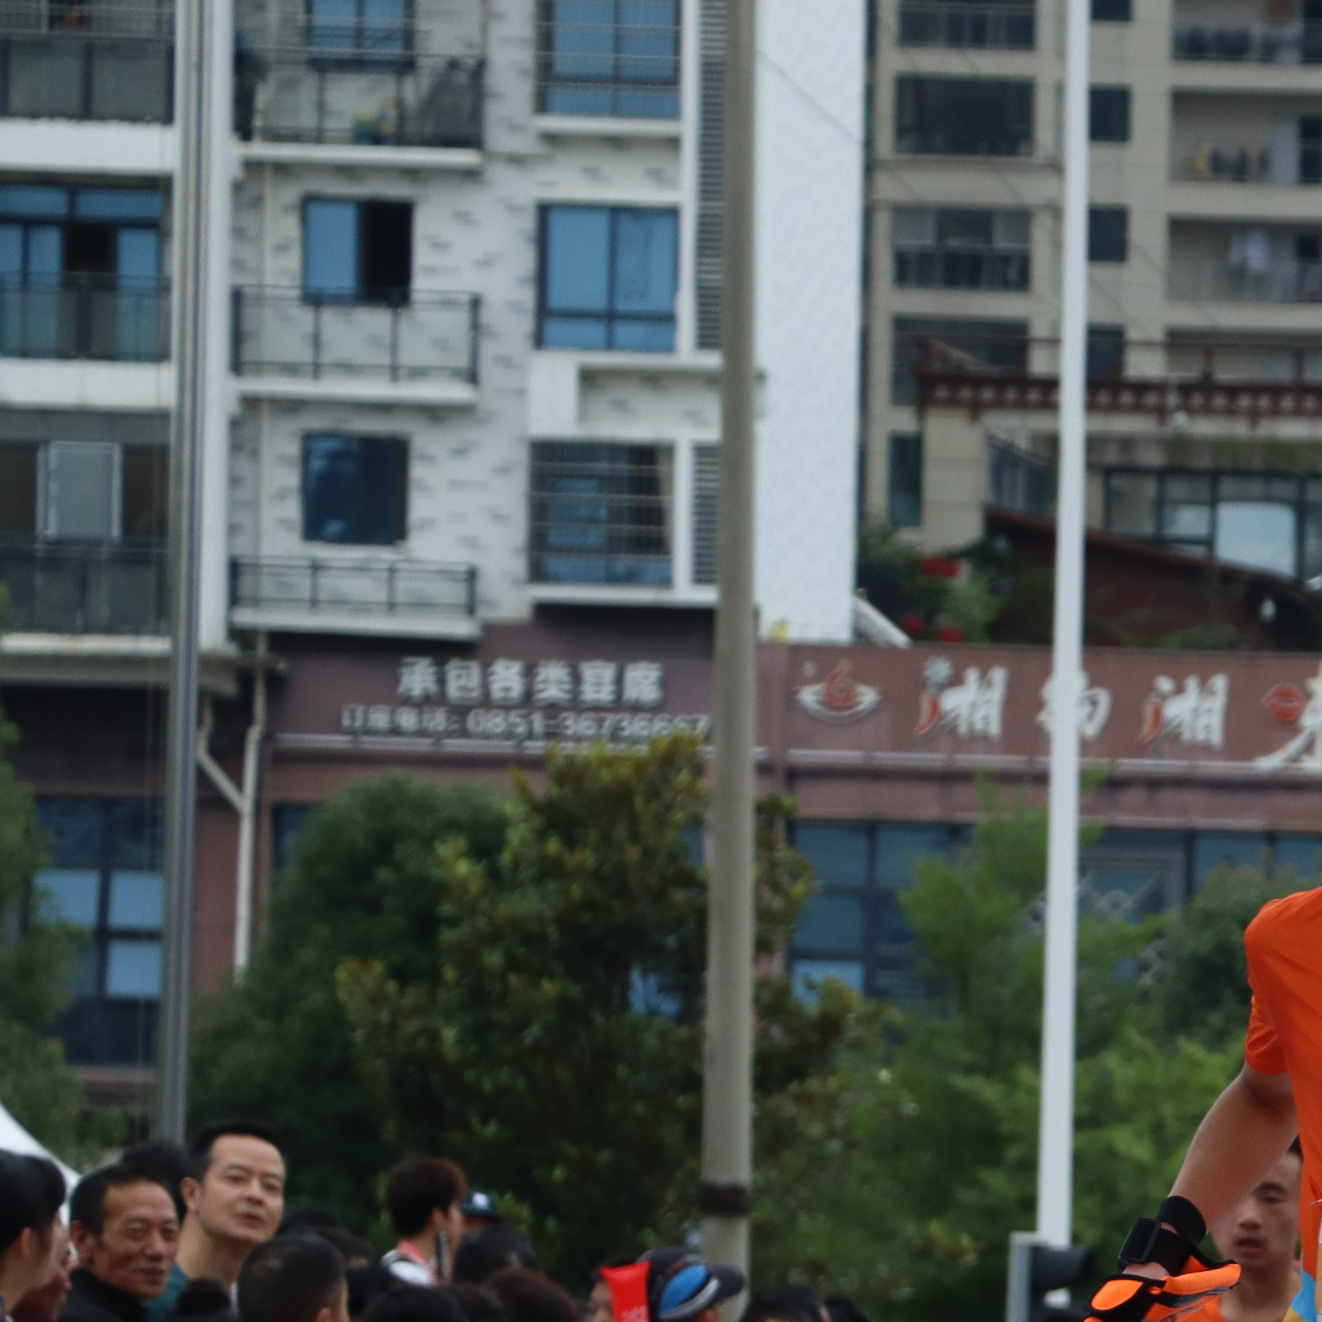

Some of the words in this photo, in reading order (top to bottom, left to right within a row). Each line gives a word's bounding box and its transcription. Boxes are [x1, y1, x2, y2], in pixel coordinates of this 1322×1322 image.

[398, 657, 664, 706] 承包各类宴席
